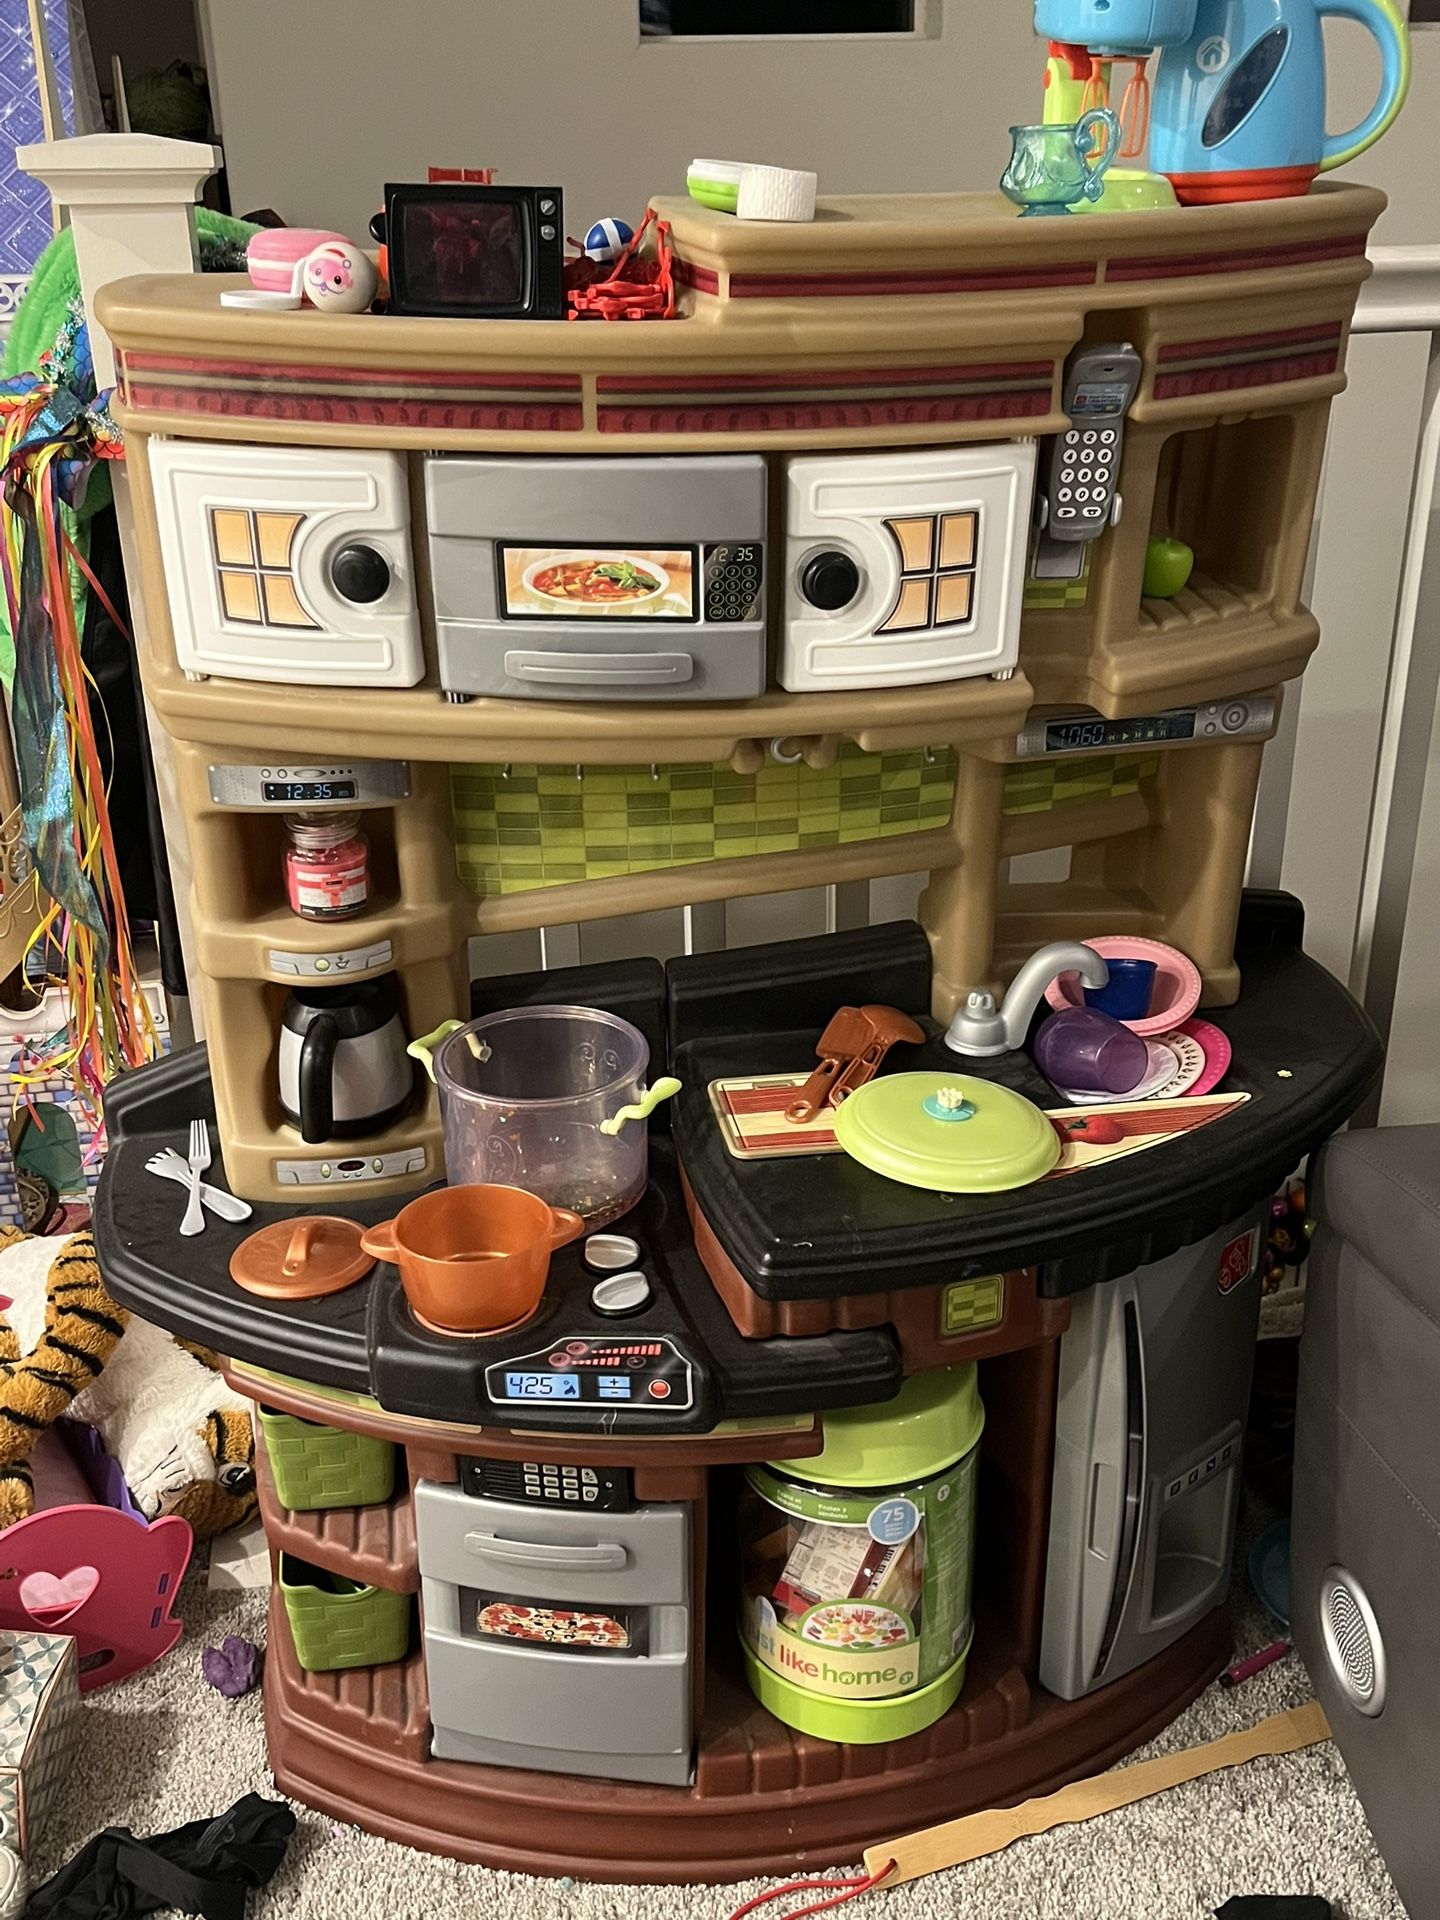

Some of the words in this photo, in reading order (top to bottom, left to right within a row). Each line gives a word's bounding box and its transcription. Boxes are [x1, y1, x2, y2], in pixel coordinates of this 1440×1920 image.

[1070, 433, 1075, 441] 1
[1086, 433, 1094, 441] 2
[1104, 433, 1111, 441] 3
[1067, 452, 1073, 460] 4
[1084, 452, 1091, 460] 5
[1102, 452, 1108, 460] 6
[1065, 472, 1071, 480] 7
[1082, 472, 1088, 480] 8
[1099, 471, 1105, 479] 9
[1079, 490, 1086, 498] 0
[712, 546, 754, 562] 12:35
[1059, 724, 1105, 747] 1060
[286, 783, 332, 799] 12:35
[881, 1506, 905, 1524] 75
[779, 1644, 819, 1678] like
[822, 1662, 897, 1686] home
